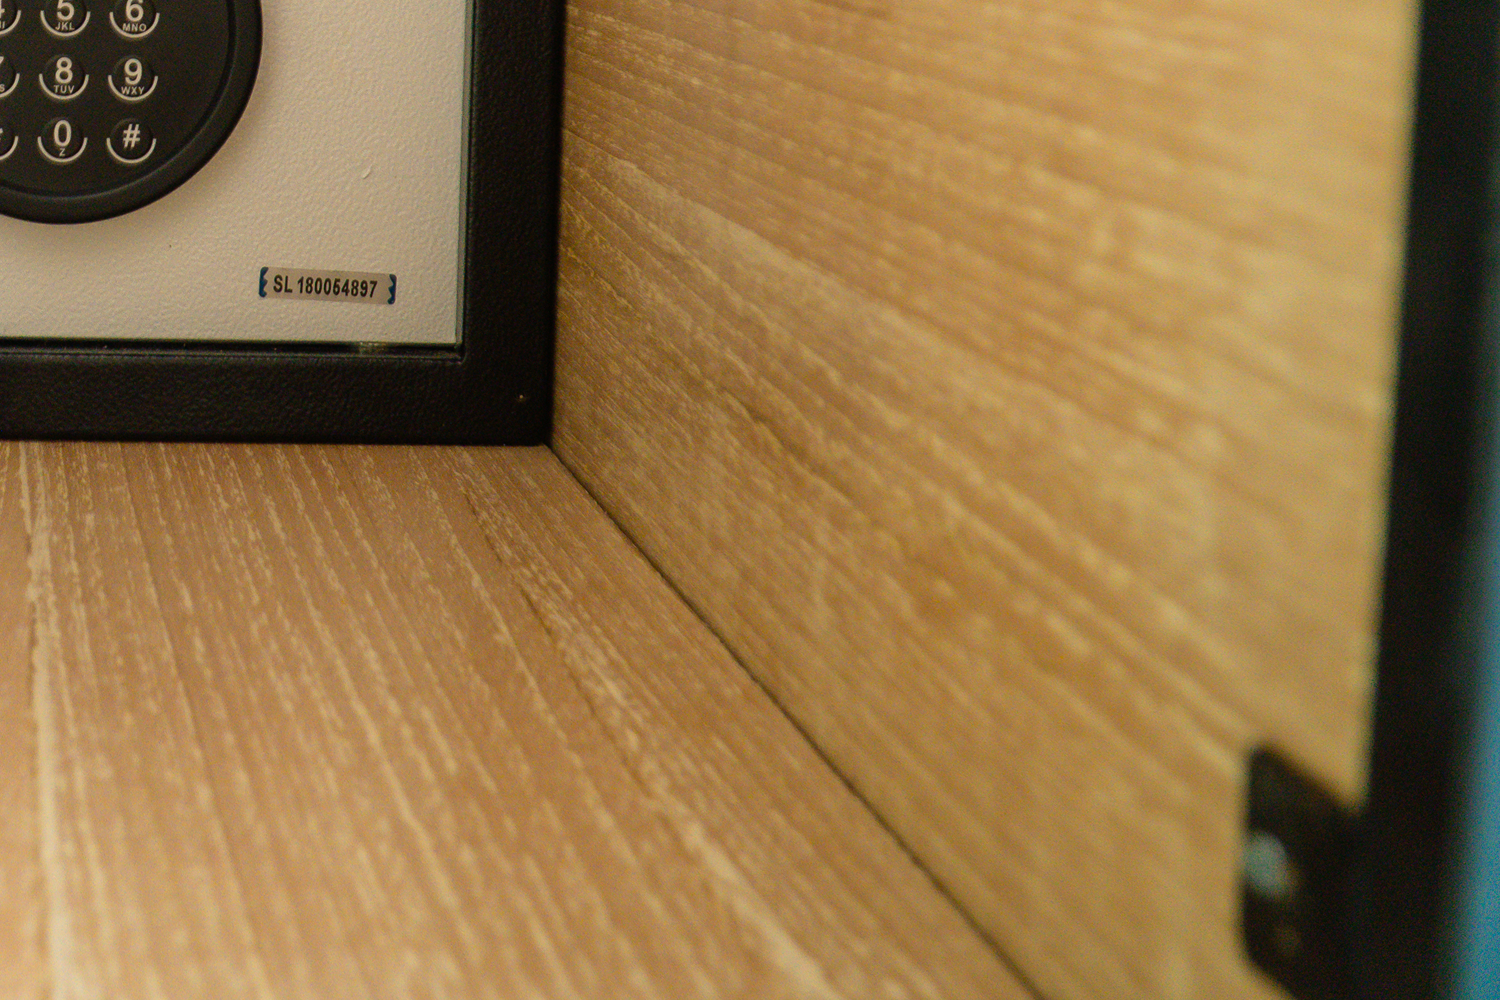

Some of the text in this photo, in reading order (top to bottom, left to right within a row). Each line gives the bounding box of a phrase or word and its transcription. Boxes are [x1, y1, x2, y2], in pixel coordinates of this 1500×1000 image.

[55, 22, 75, 31] JKL
[122, 23, 147, 32] MNO
[54, 56, 73, 84] 8
[124, 58, 143, 86] 9
[53, 85, 75, 94] TUV
[121, 86, 145, 95] WXY
[53, 119, 72, 147] 0
[59, 148, 66, 157] Z
[273, 274, 293, 293] SL
